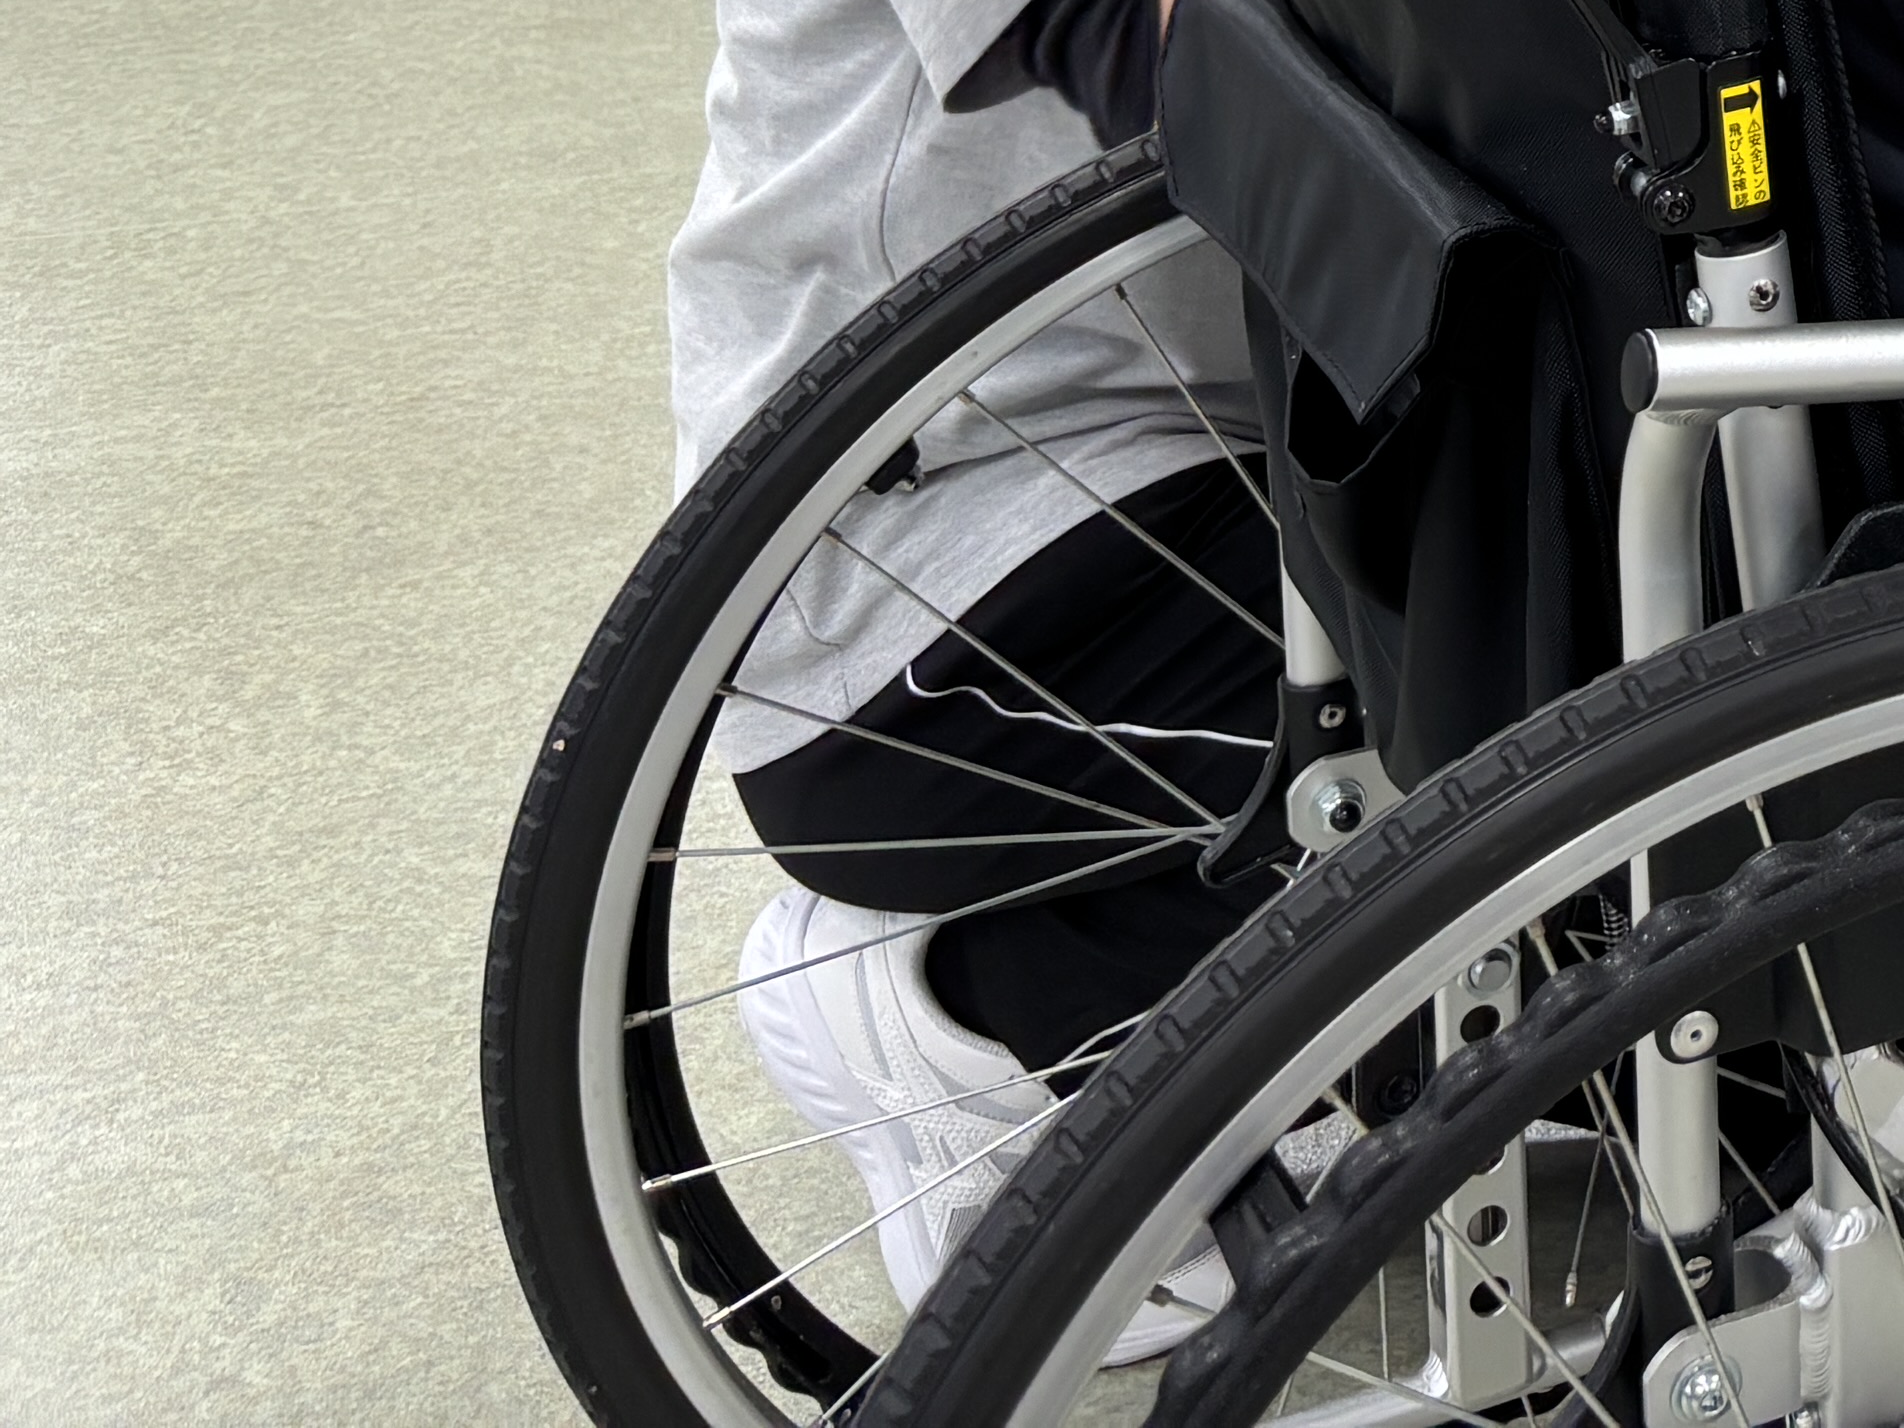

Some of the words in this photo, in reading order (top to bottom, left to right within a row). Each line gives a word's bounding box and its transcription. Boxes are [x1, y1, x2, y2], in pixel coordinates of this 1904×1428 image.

[1728, 122, 1749, 208] 飛び込み確認
